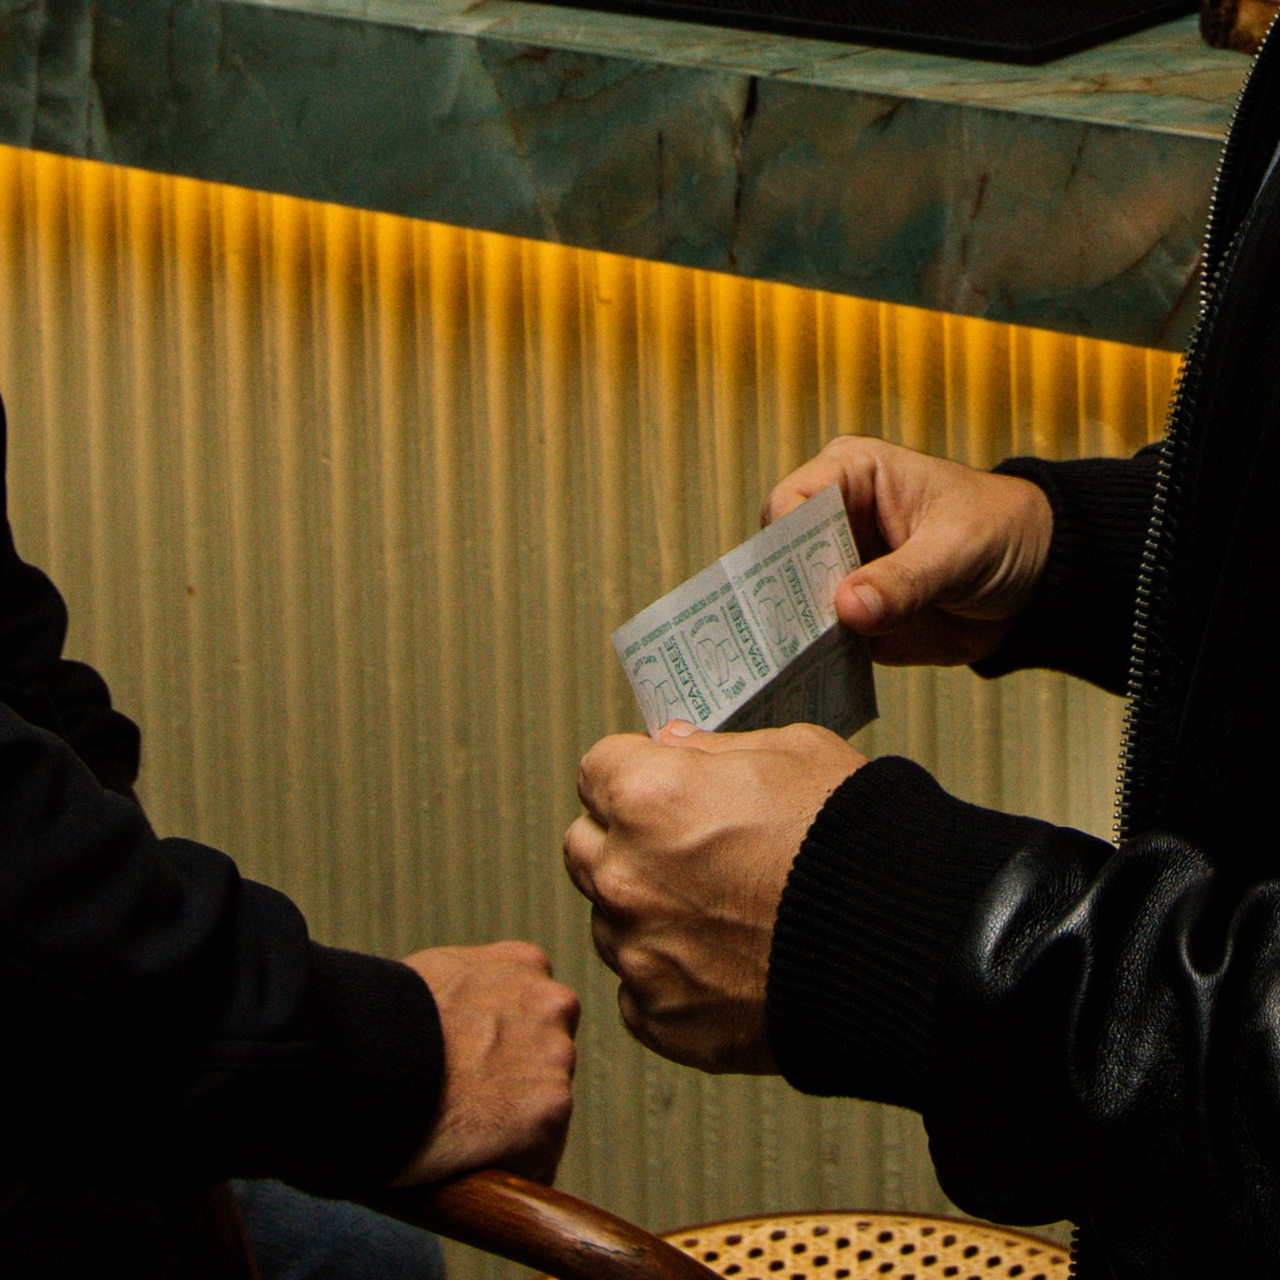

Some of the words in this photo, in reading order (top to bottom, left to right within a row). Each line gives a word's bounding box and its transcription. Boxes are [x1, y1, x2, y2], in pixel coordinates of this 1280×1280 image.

[725, 597, 750, 644] FREE
[663, 637, 690, 686] FREE
[748, 644, 769, 678] BPA
[688, 688, 709, 721] BPA
